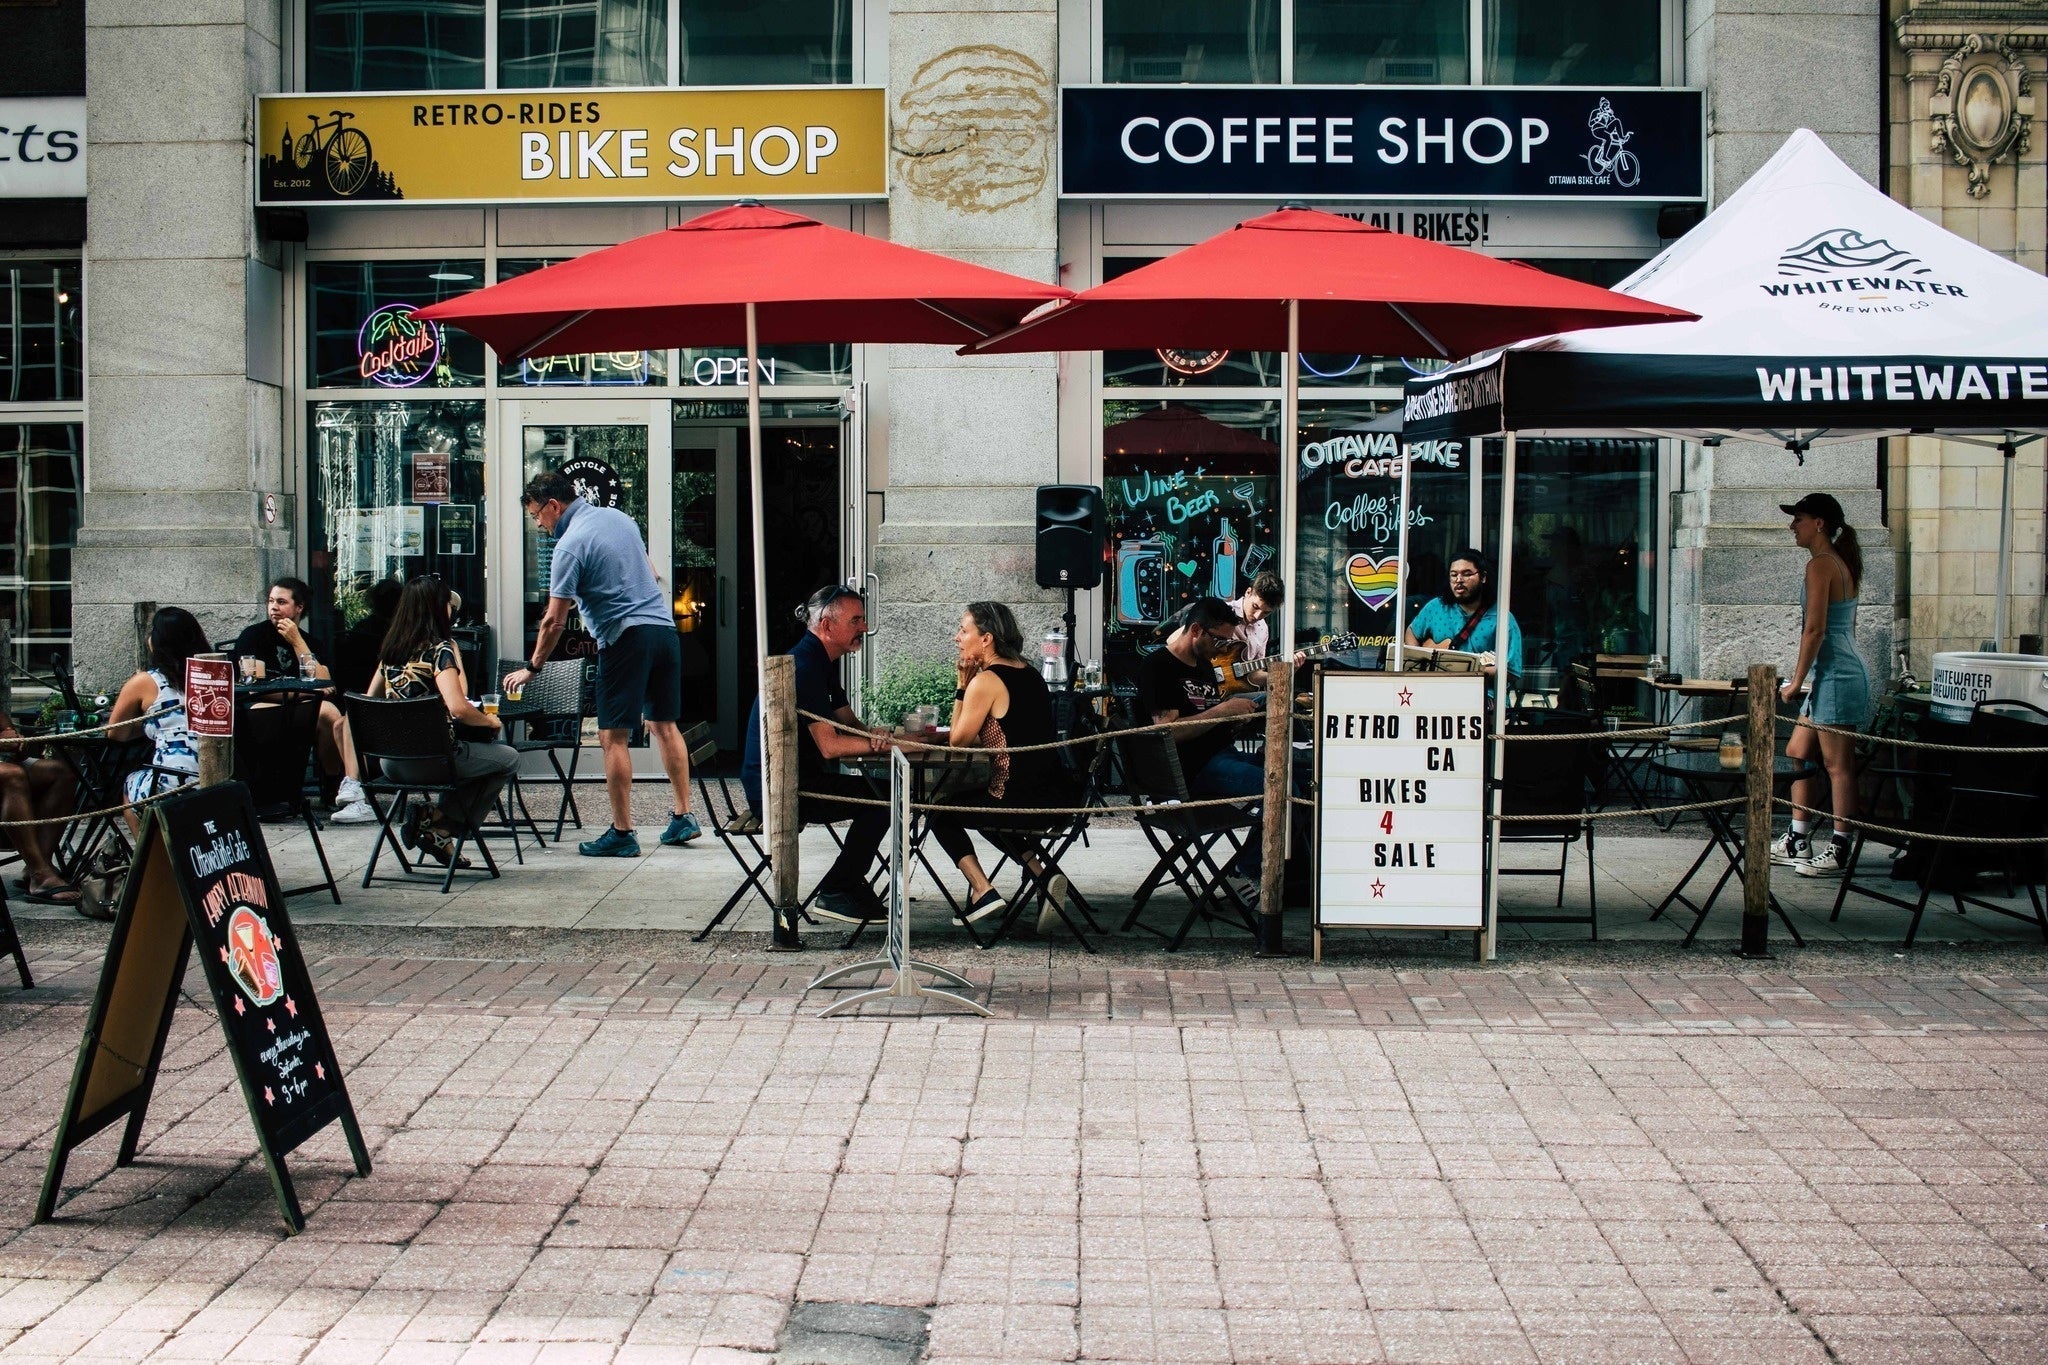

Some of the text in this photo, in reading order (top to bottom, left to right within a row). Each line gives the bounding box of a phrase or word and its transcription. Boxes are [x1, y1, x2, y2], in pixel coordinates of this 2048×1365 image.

[413, 102, 600, 126] RETRO-RIDES
[521, 125, 839, 181] BIKE SHOP
[1120, 116, 1550, 165] COFFEE SHOP
[273, 180, 311, 188] Est. 2012
[1549, 175, 1577, 185] OTTAWA
[1577, 175, 1593, 185] BIKE
[1414, 212, 1489, 242] BIKES!
[1759, 277, 1969, 298] WHITEWATER
[1818, 301, 1905, 314] BREWING
[1302, 433, 1399, 469] OTTAWA
[564, 461, 607, 475] BICYCLE
[1325, 493, 1388, 532] Coffee
[1933, 668, 1992, 688] WHITEWATER
[1932, 683, 1967, 701] BREWING
[1326, 714, 1482, 740] RETRO RIDES
[1427, 746, 1455, 772] CA
[1359, 778, 1427, 804] BIKES
[203, 820, 217, 835] THE
[1380, 810, 1393, 835] 4
[1374, 843, 1435, 868] SALE
[202, 880, 230, 928] HAPPY
